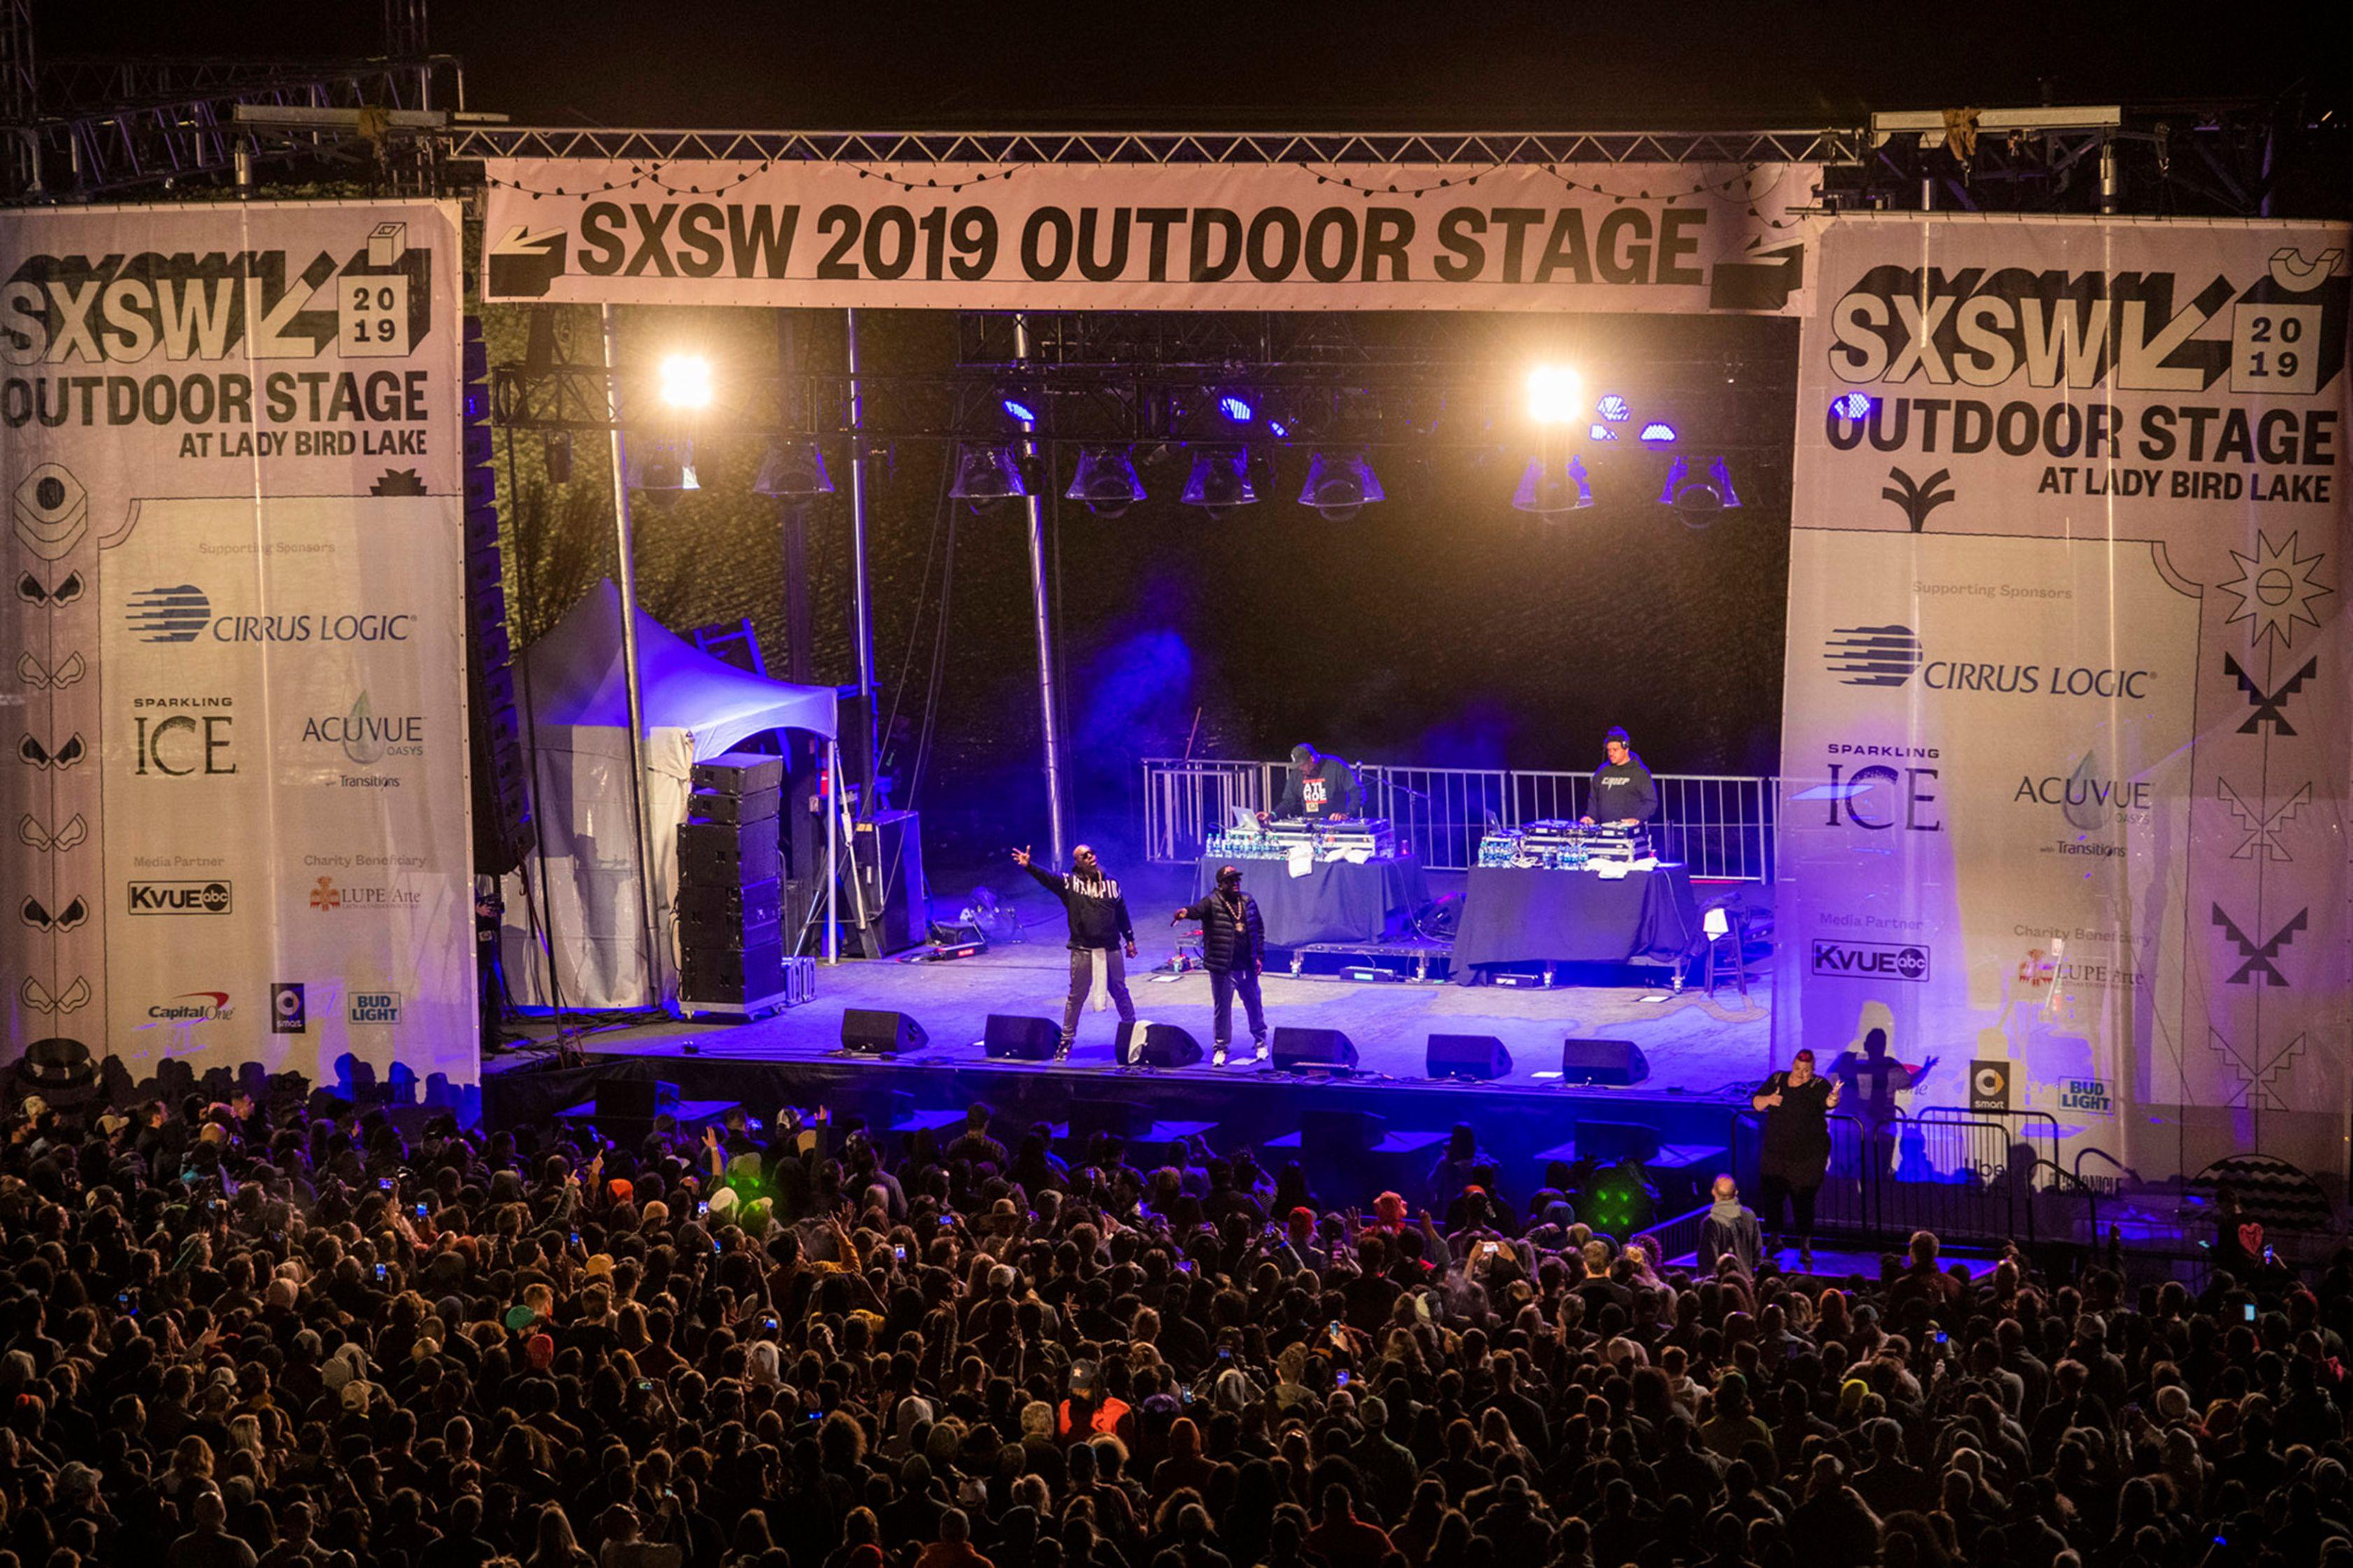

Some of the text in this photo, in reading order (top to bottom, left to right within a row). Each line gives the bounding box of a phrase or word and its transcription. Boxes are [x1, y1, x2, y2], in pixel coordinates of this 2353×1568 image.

[578, 201, 1708, 285] SXSW 2019 OUTDOOR STAGE
[353, 287, 394, 310] 20
[0, 276, 235, 366] SXSW
[354, 319, 396, 342] 19
[2251, 317, 2302, 342] 20
[1828, 291, 2111, 389] SXSW
[2249, 352, 2299, 376] 19
[1, 370, 428, 428] OUTDOOR STAGE
[1826, 395, 2338, 466] OUTDOOR STAGE
[179, 429, 427, 457] AT LADY BIRD LAKE
[2038, 466, 2331, 503] AT LADY BIRD LAKE
[199, 542, 336, 556] Supporting Sponsors
[1913, 581, 2073, 600] Supporting Sponsors
[213, 614, 409, 641] CIRRUS LOGIC
[1924, 660, 2148, 699] CIRRUS LOGIC
[134, 697, 233, 708] SPARKLING
[302, 716, 423, 742] ACUVUE
[134, 715, 237, 776] ICE
[387, 746, 423, 756] OASYS
[1827, 743, 1940, 759] SPARKLING
[340, 775, 400, 789] Transitions
[1827, 763, 1941, 831] ICE
[2014, 775, 2151, 810] ACUVUE
[2057, 840, 2126, 858] Transitions
[134, 855, 224, 867] Media Partner
[304, 854, 351, 868] Charity
[131, 886, 228, 908] KVUE abc
[342, 888, 421, 903] LUPE Arte
[1820, 913, 1924, 930] Media Partner
[2013, 924, 2071, 941] Charity
[1815, 945, 1926, 973] KVUE abc
[2057, 964, 2107, 982] LUPE
[357, 995, 392, 1008] BUD
[148, 1005, 234, 1020] Capital One
[352, 1008, 398, 1021] LIGHT
[2070, 1080, 2104, 1095] BUD
[1975, 1100, 2004, 1109] smart
[2062, 1094, 2111, 1111] LIGHT
